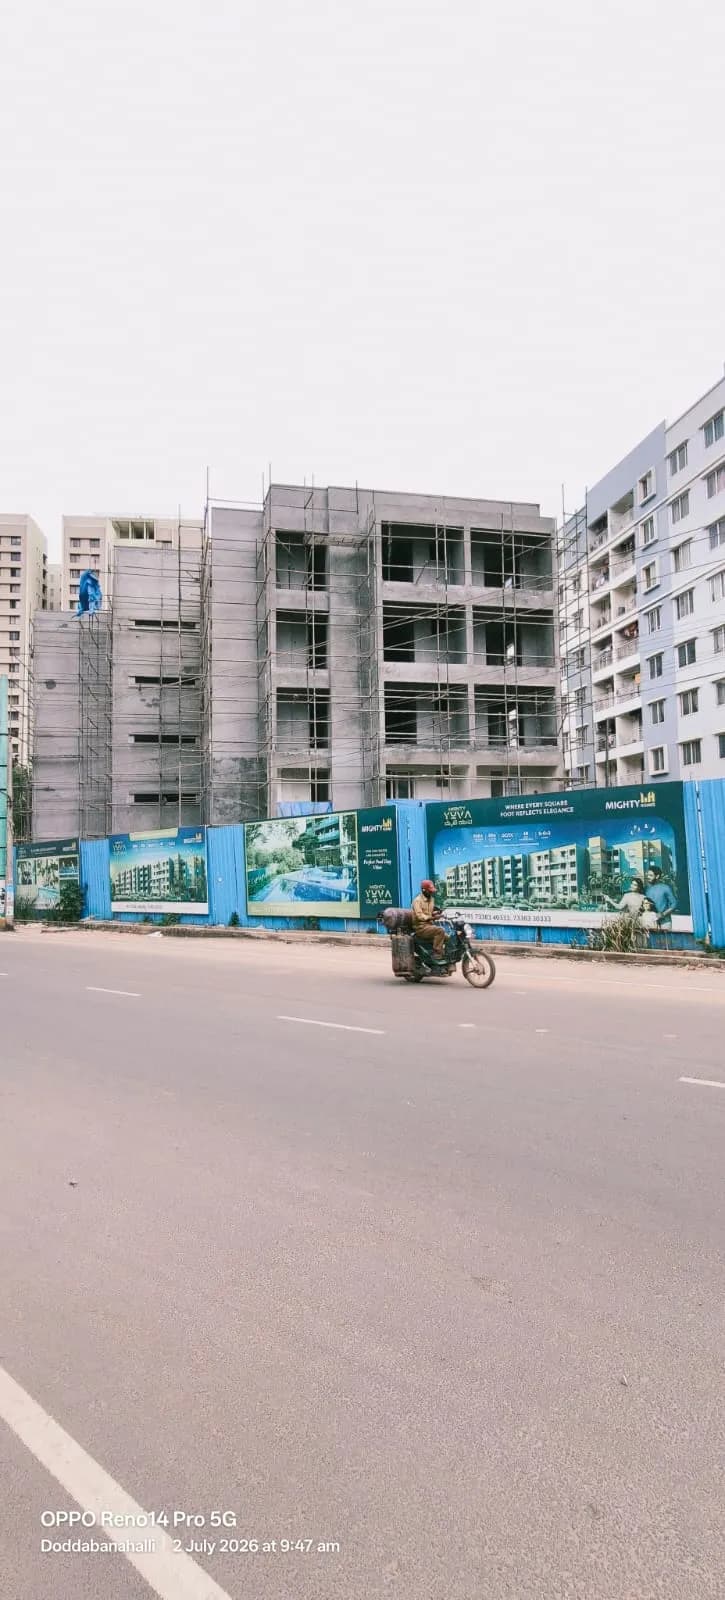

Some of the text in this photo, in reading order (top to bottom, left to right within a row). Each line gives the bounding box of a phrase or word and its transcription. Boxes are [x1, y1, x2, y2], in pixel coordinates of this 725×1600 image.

[544, 799, 569, 807] SQUARE
[606, 799, 640, 810] MIGHTY
[543, 806, 575, 815] ELEGANCE
